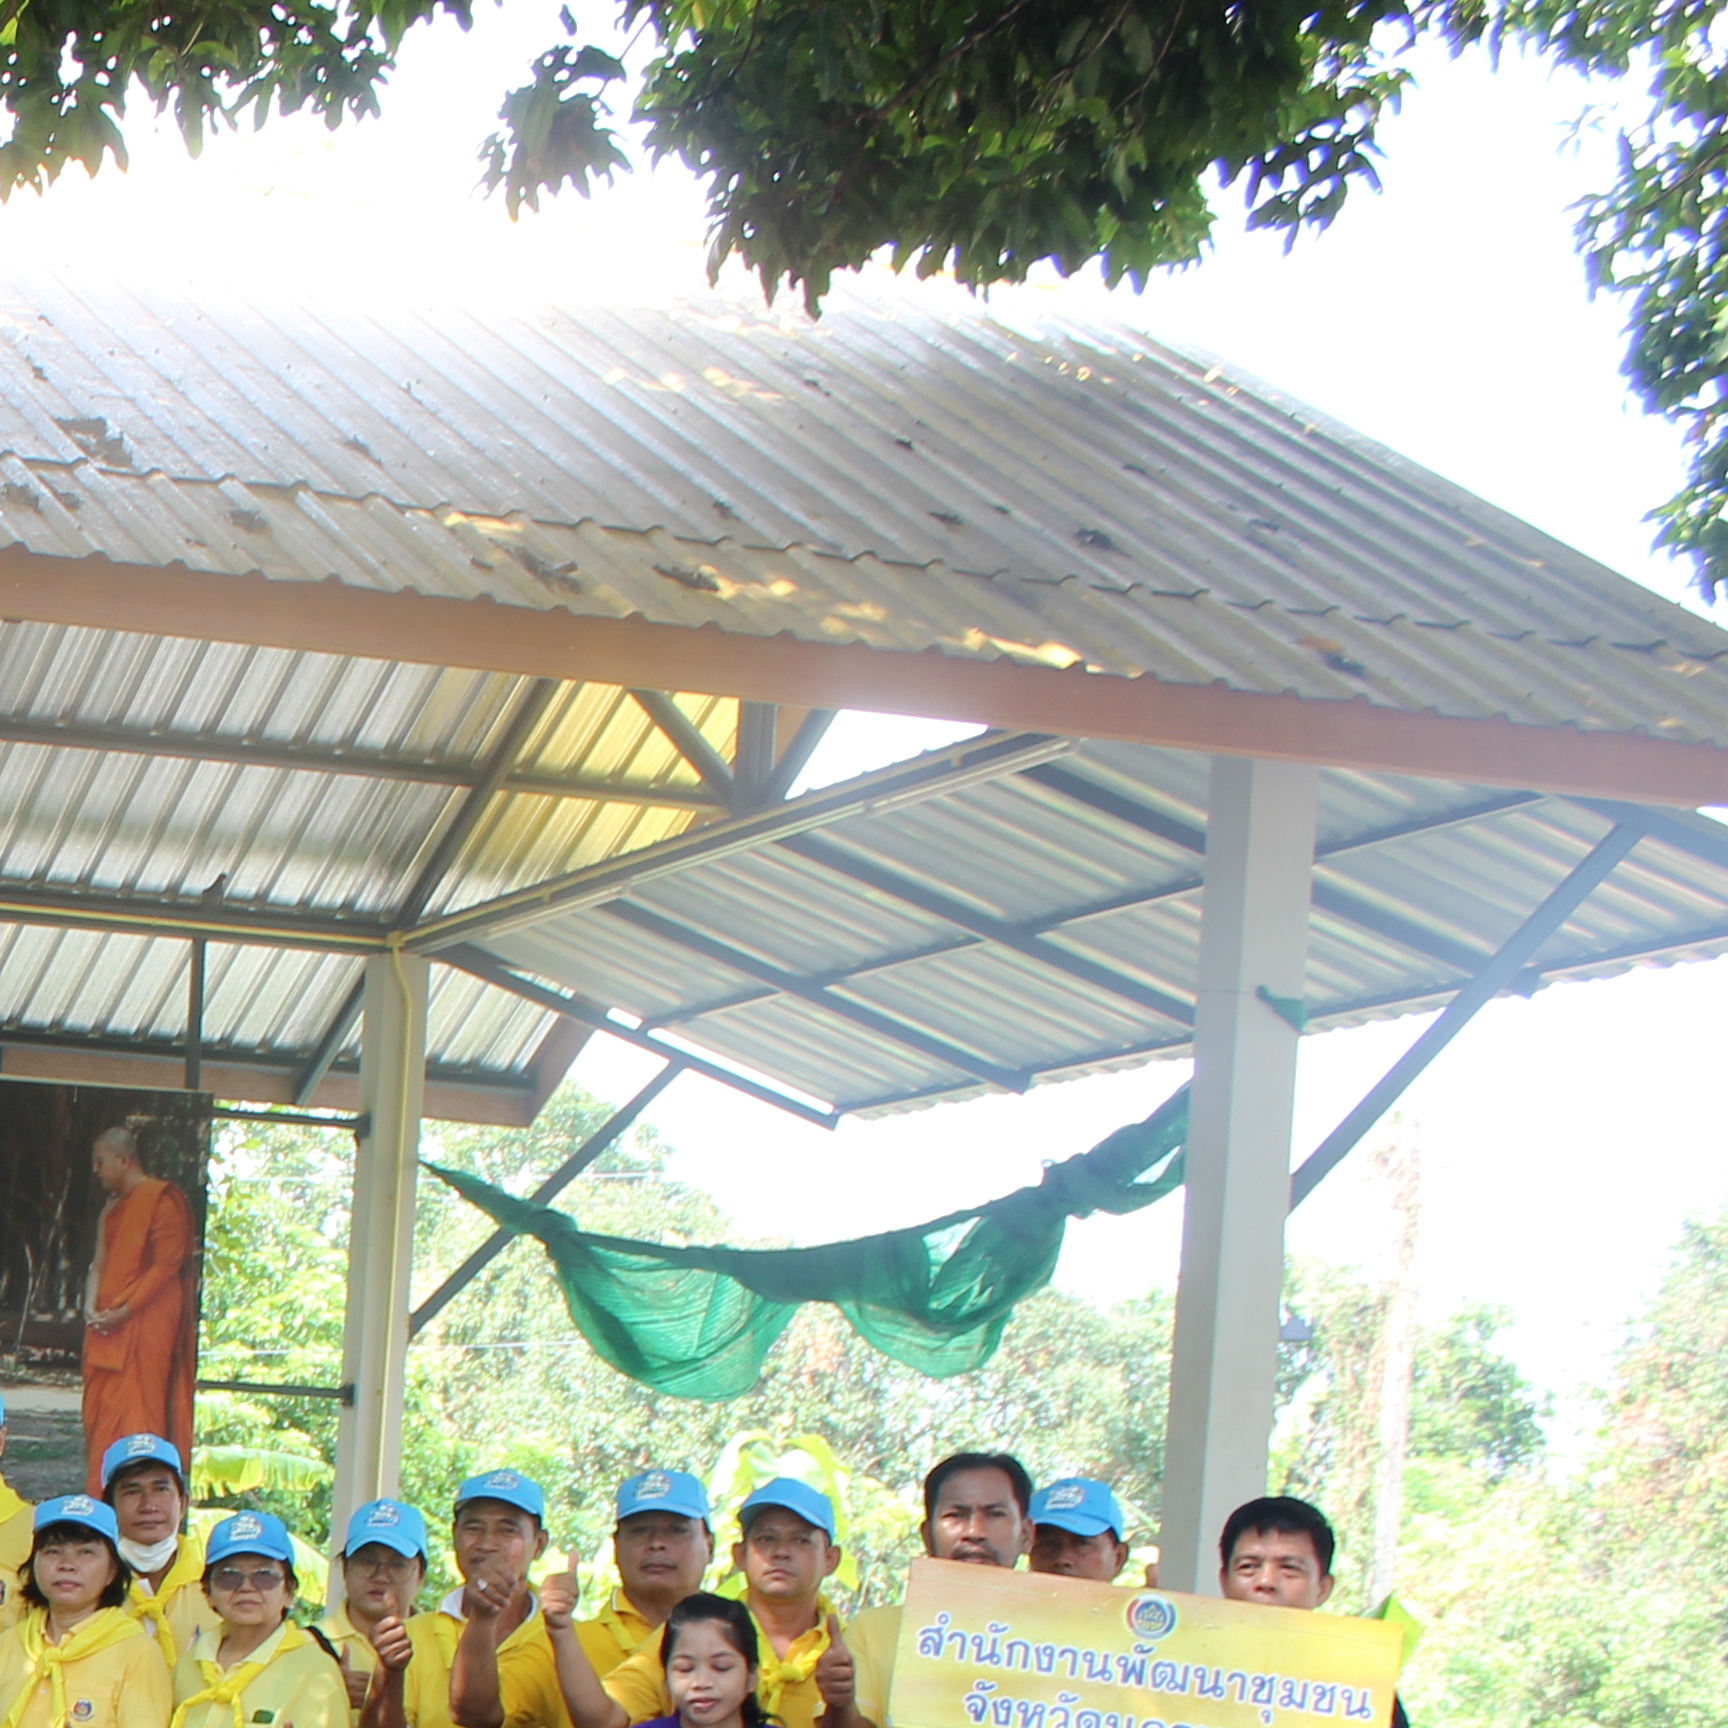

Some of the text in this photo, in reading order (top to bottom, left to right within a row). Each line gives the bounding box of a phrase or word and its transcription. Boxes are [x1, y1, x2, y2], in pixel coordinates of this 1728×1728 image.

[918, 1613, 1372, 1722] สำนักงานพัฒนาชุมชน
